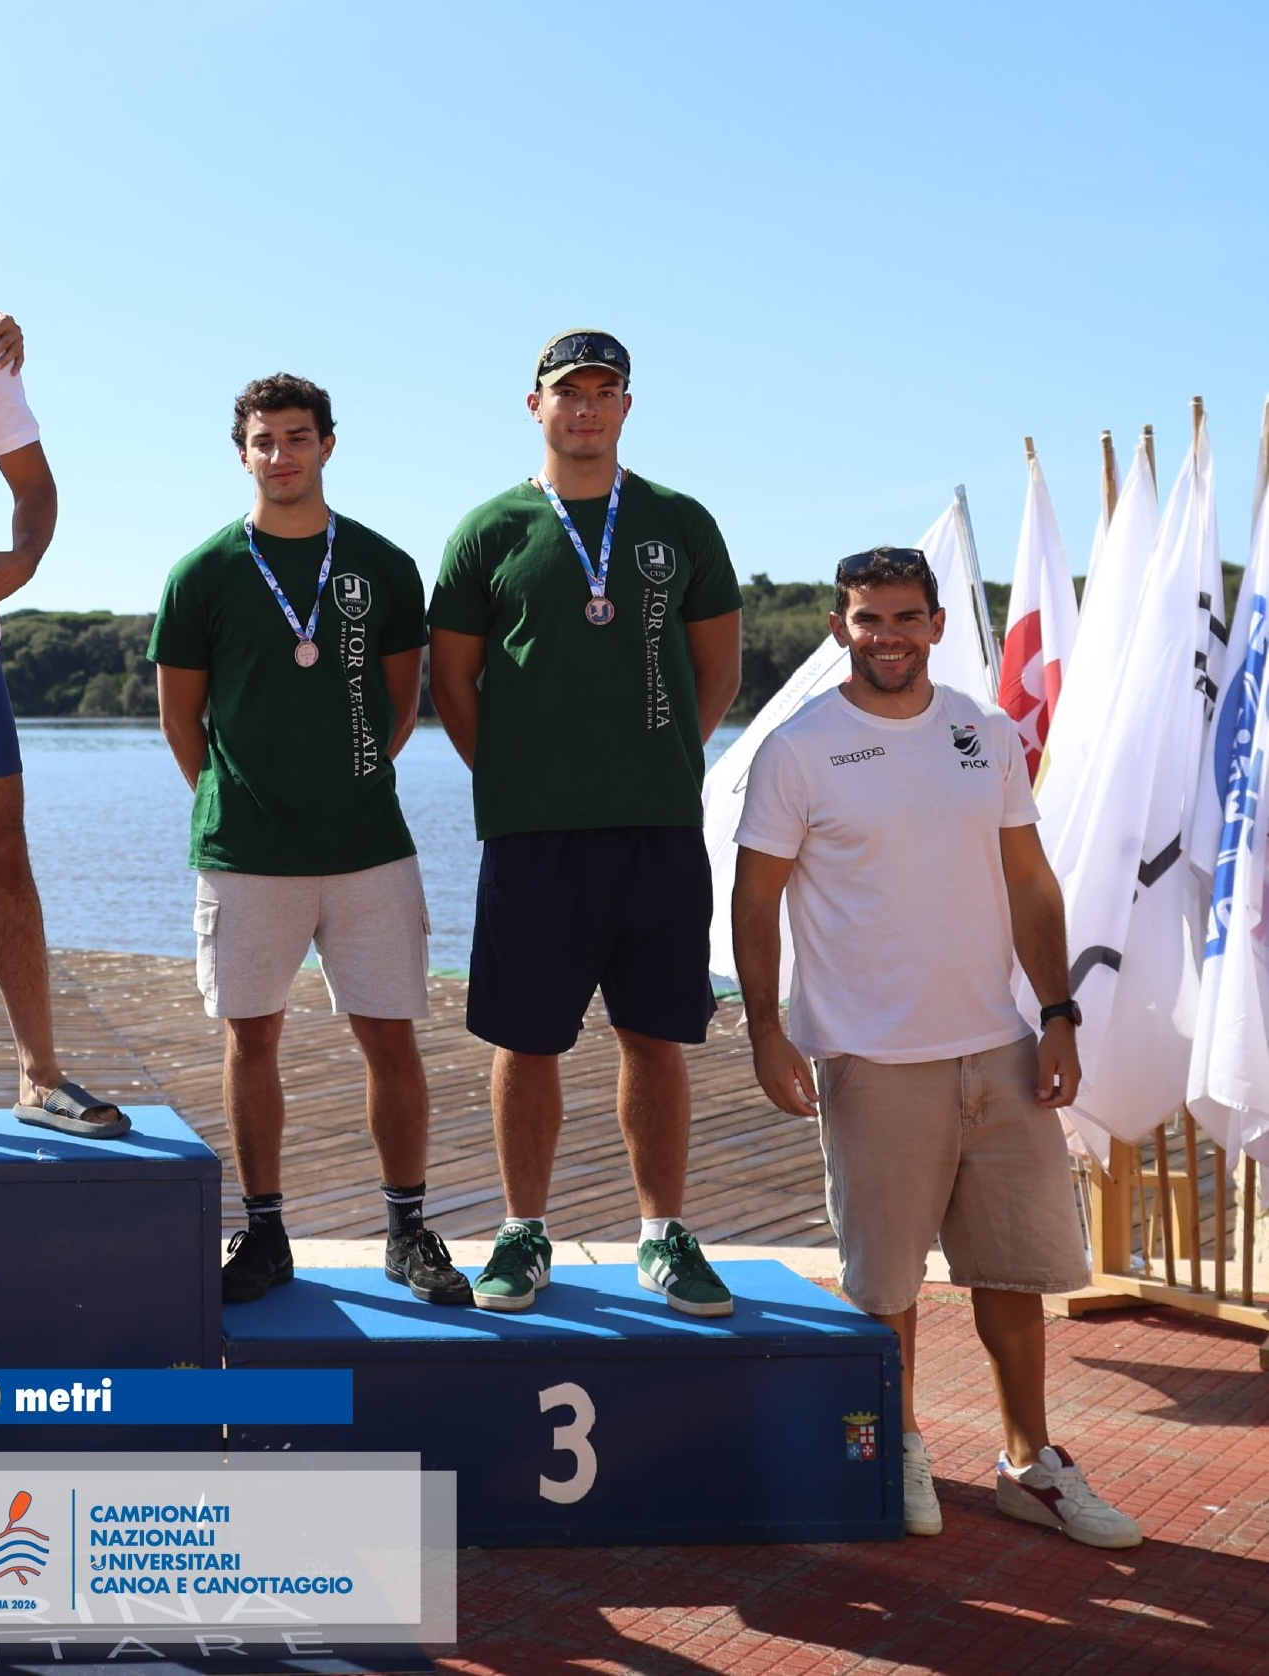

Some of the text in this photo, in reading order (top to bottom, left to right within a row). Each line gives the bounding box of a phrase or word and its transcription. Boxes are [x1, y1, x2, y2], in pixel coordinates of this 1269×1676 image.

[650, 570, 666, 578] CUS
[346, 605, 362, 613] CUS
[648, 590, 668, 630] TOR
[347, 623, 366, 669] TOR
[830, 746, 885, 766] Kappa
[960, 759, 990, 769] FICK
[539, 1381, 598, 1504] 3
